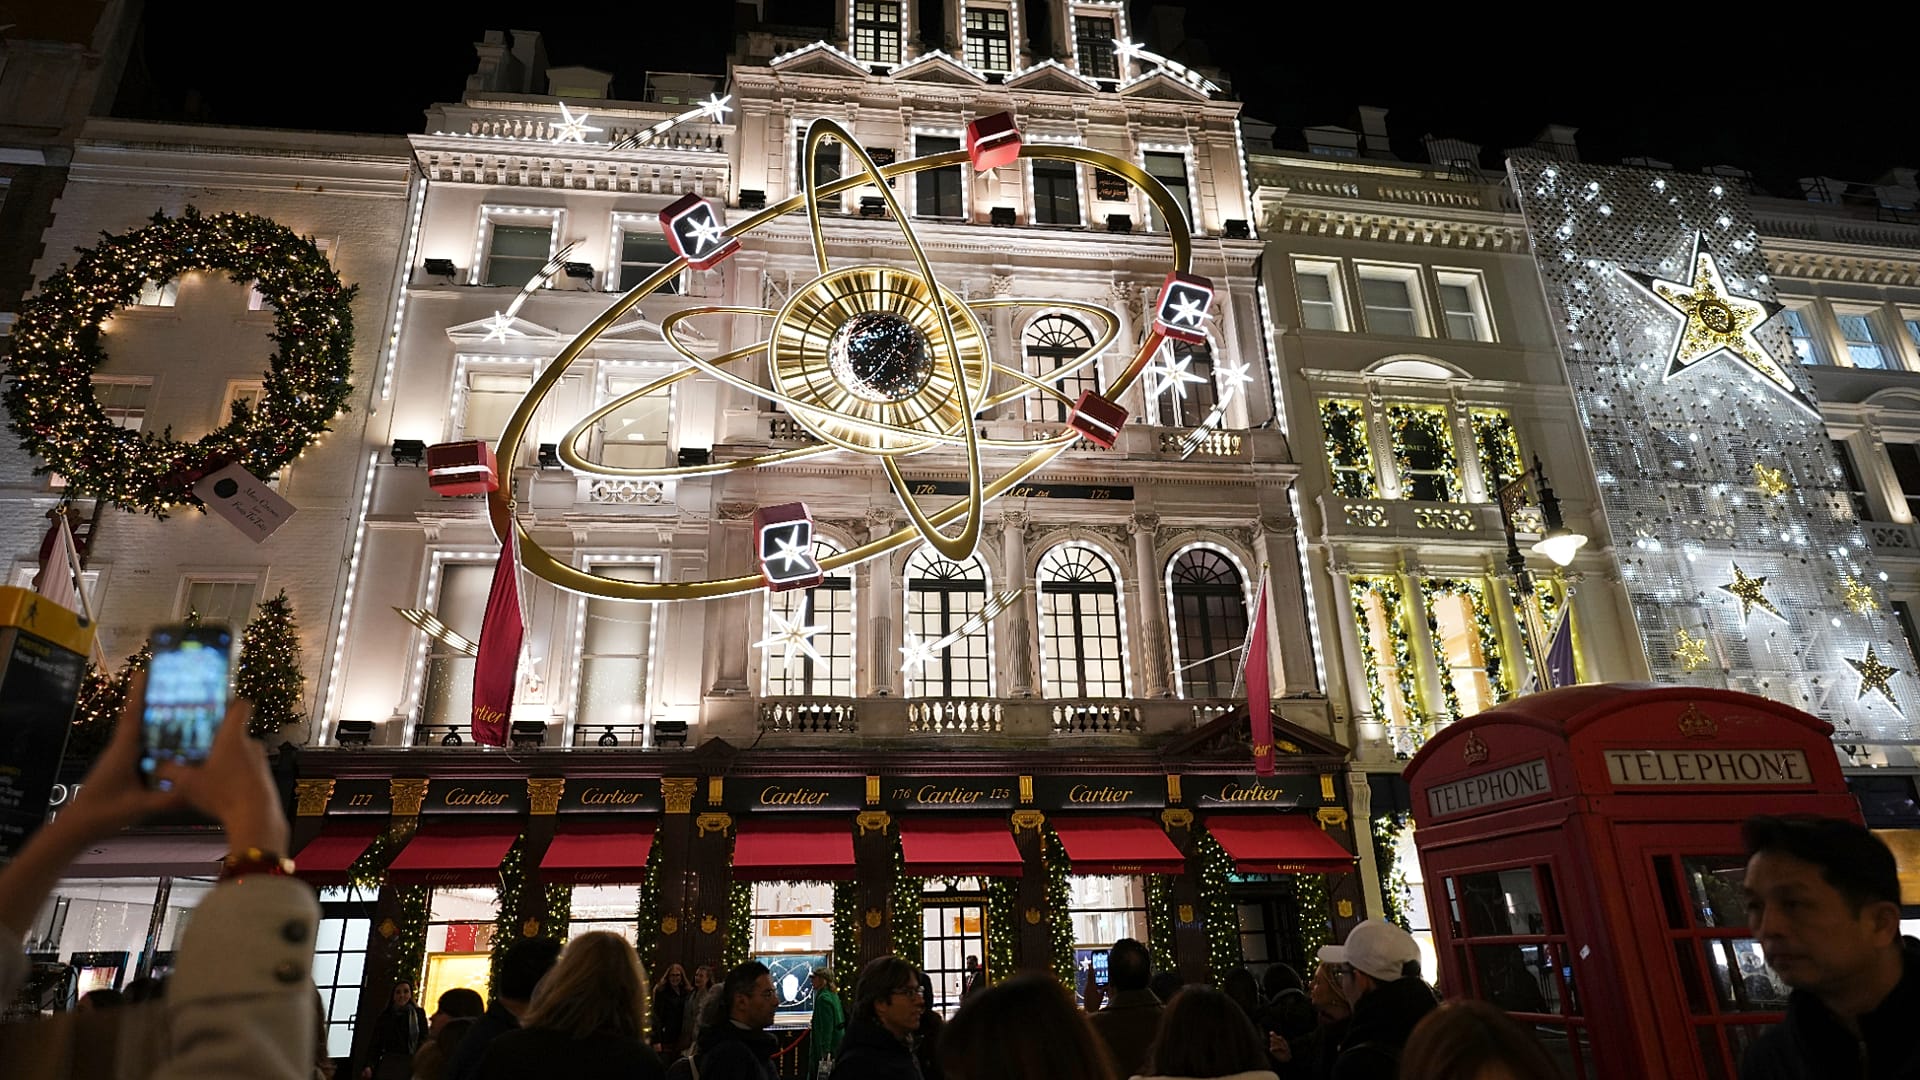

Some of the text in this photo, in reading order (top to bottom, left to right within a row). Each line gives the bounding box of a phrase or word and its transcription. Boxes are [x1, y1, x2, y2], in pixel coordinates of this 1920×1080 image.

[914, 484, 937, 495] 176
[1089, 489, 1110, 500] 175
[473, 704, 506, 724] rtier
[1611, 753, 1803, 781] TELEPHONE
[445, 787, 509, 806] Cartier
[580, 787, 643, 805] Cartier
[760, 785, 830, 805] Cartier
[892, 784, 1011, 804] 176 Cartier 175
[1069, 784, 1133, 804] Cartier
[1220, 782, 1283, 802] Cartier
[1431, 762, 1547, 814] TELEPHONE
[349, 794, 373, 806] 177
[425, 871, 462, 881] Cartier
[574, 870, 609, 881] Cartier
